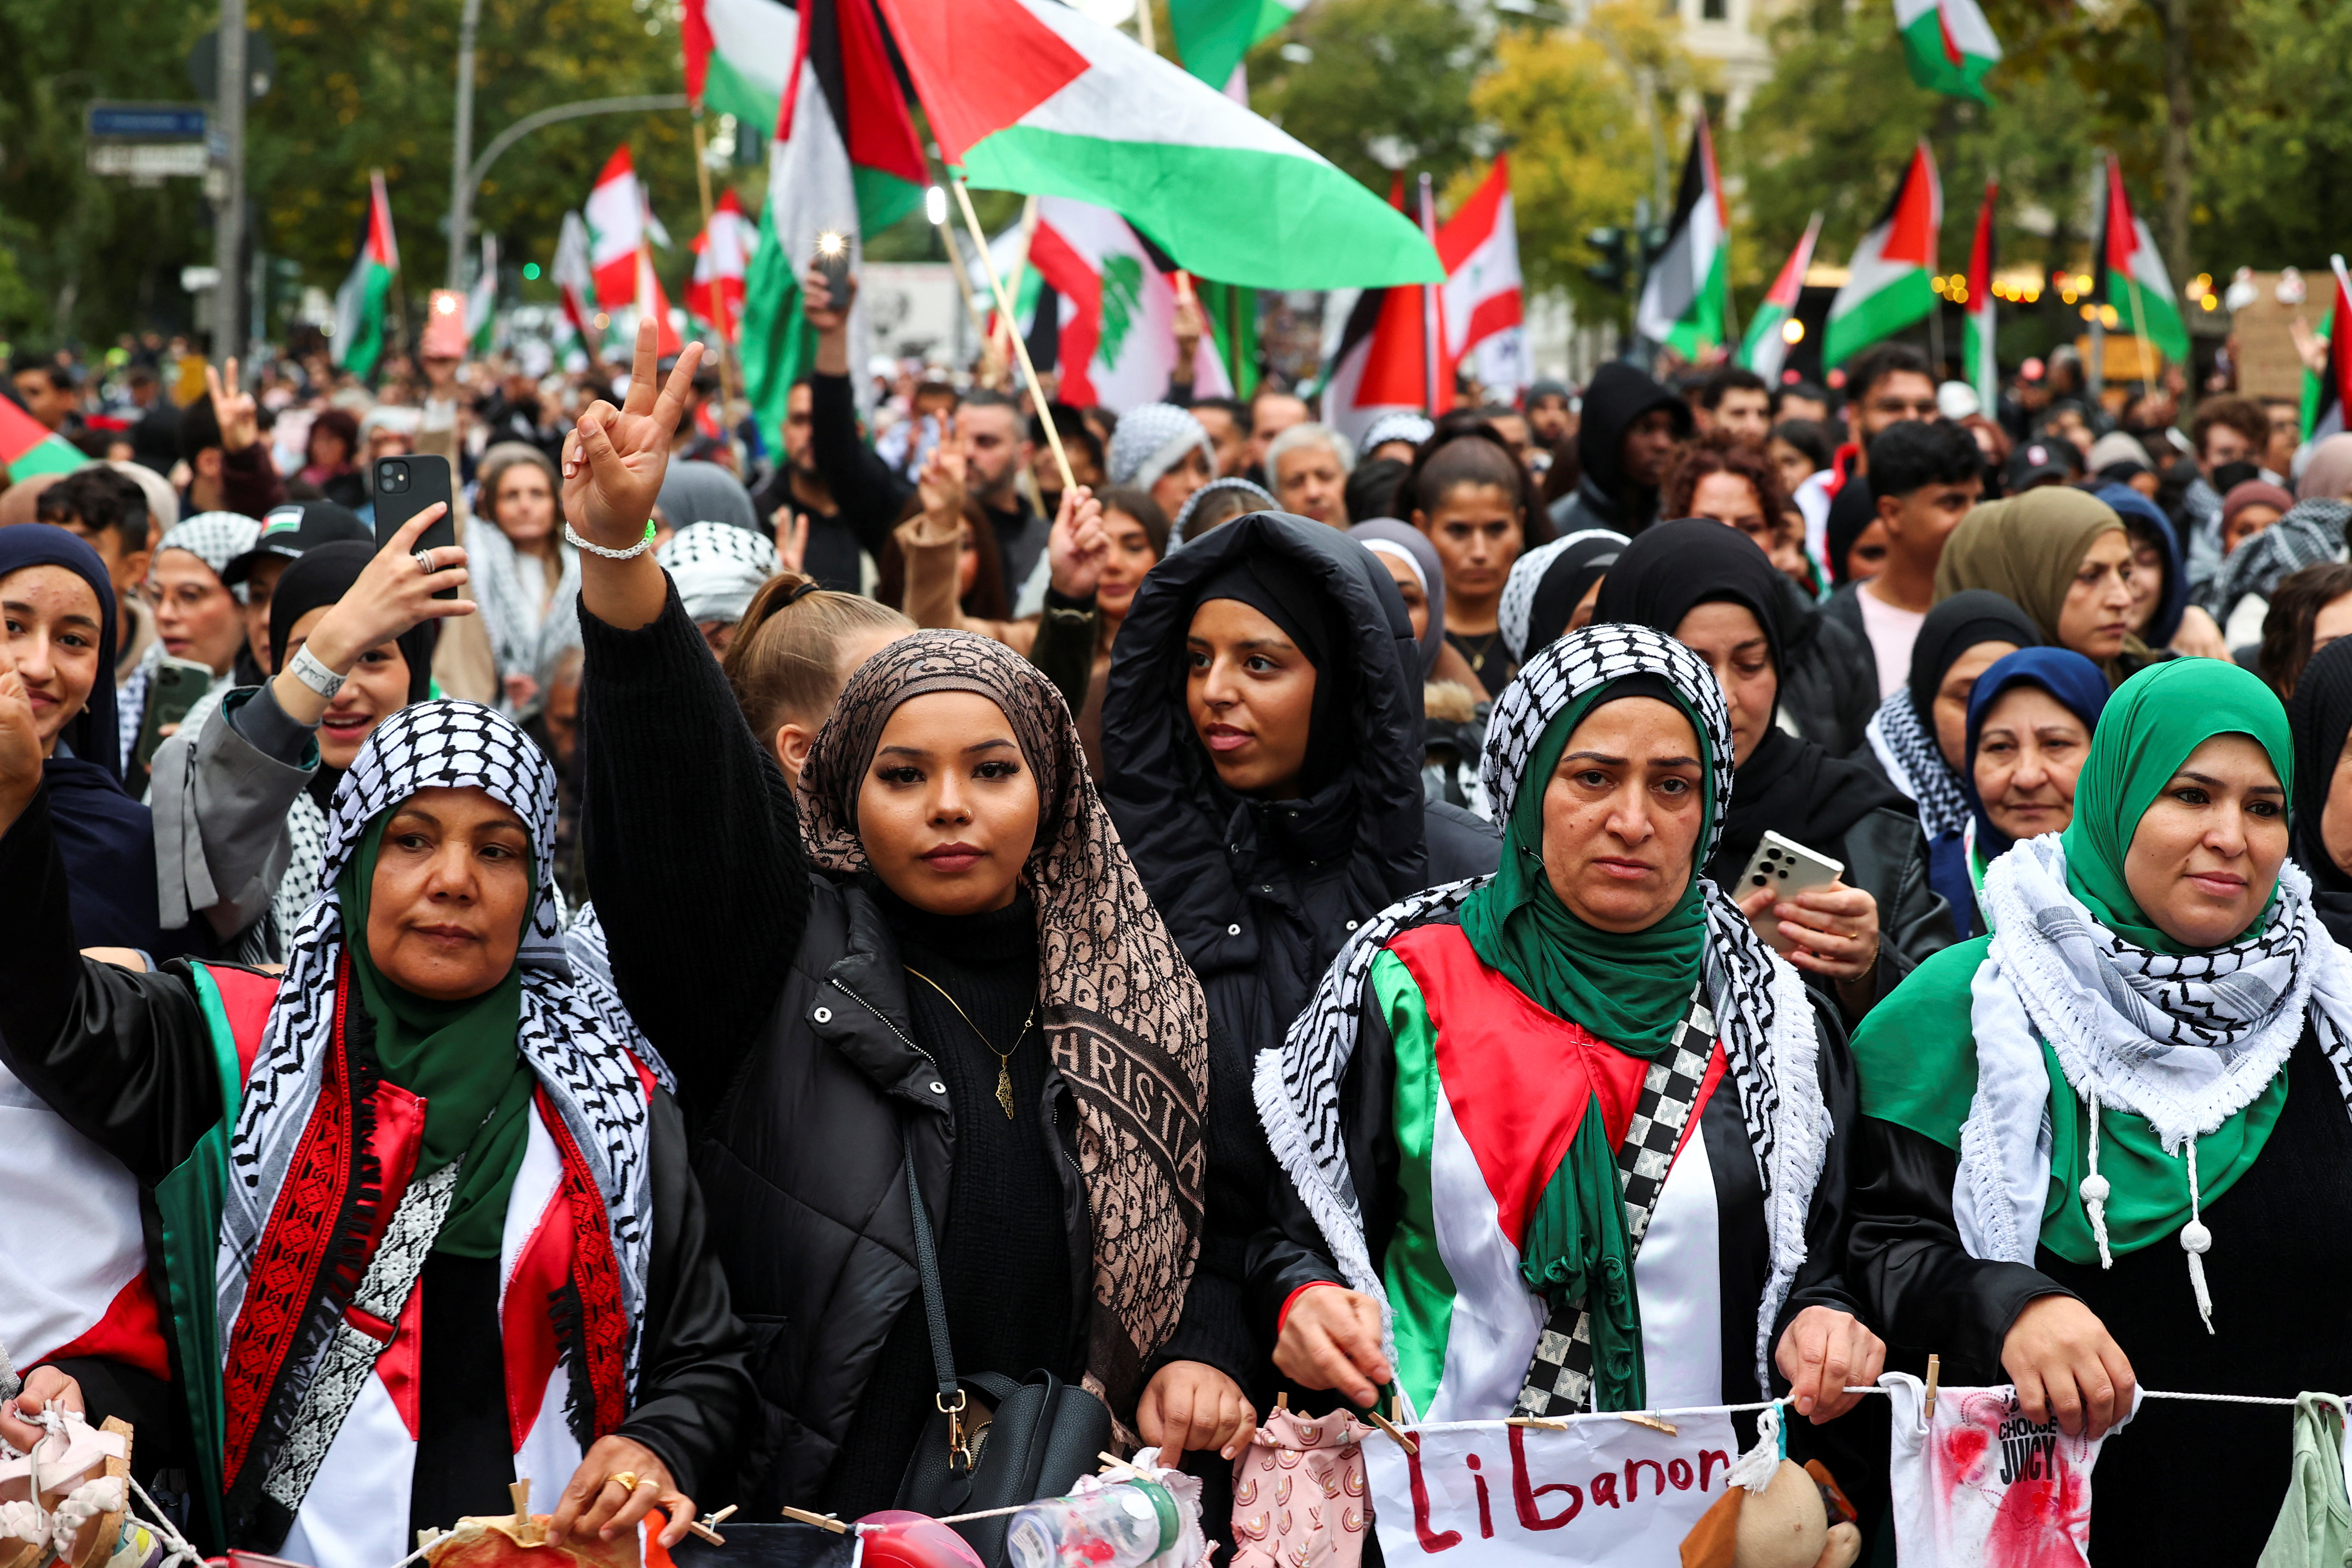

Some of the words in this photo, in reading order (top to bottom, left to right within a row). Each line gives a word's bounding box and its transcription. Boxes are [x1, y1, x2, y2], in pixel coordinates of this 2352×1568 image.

[1051, 1032, 1201, 1189] HRISTIA
[1406, 1424, 1730, 1553] Libanon
[2000, 1435, 2056, 1485] JUICY
